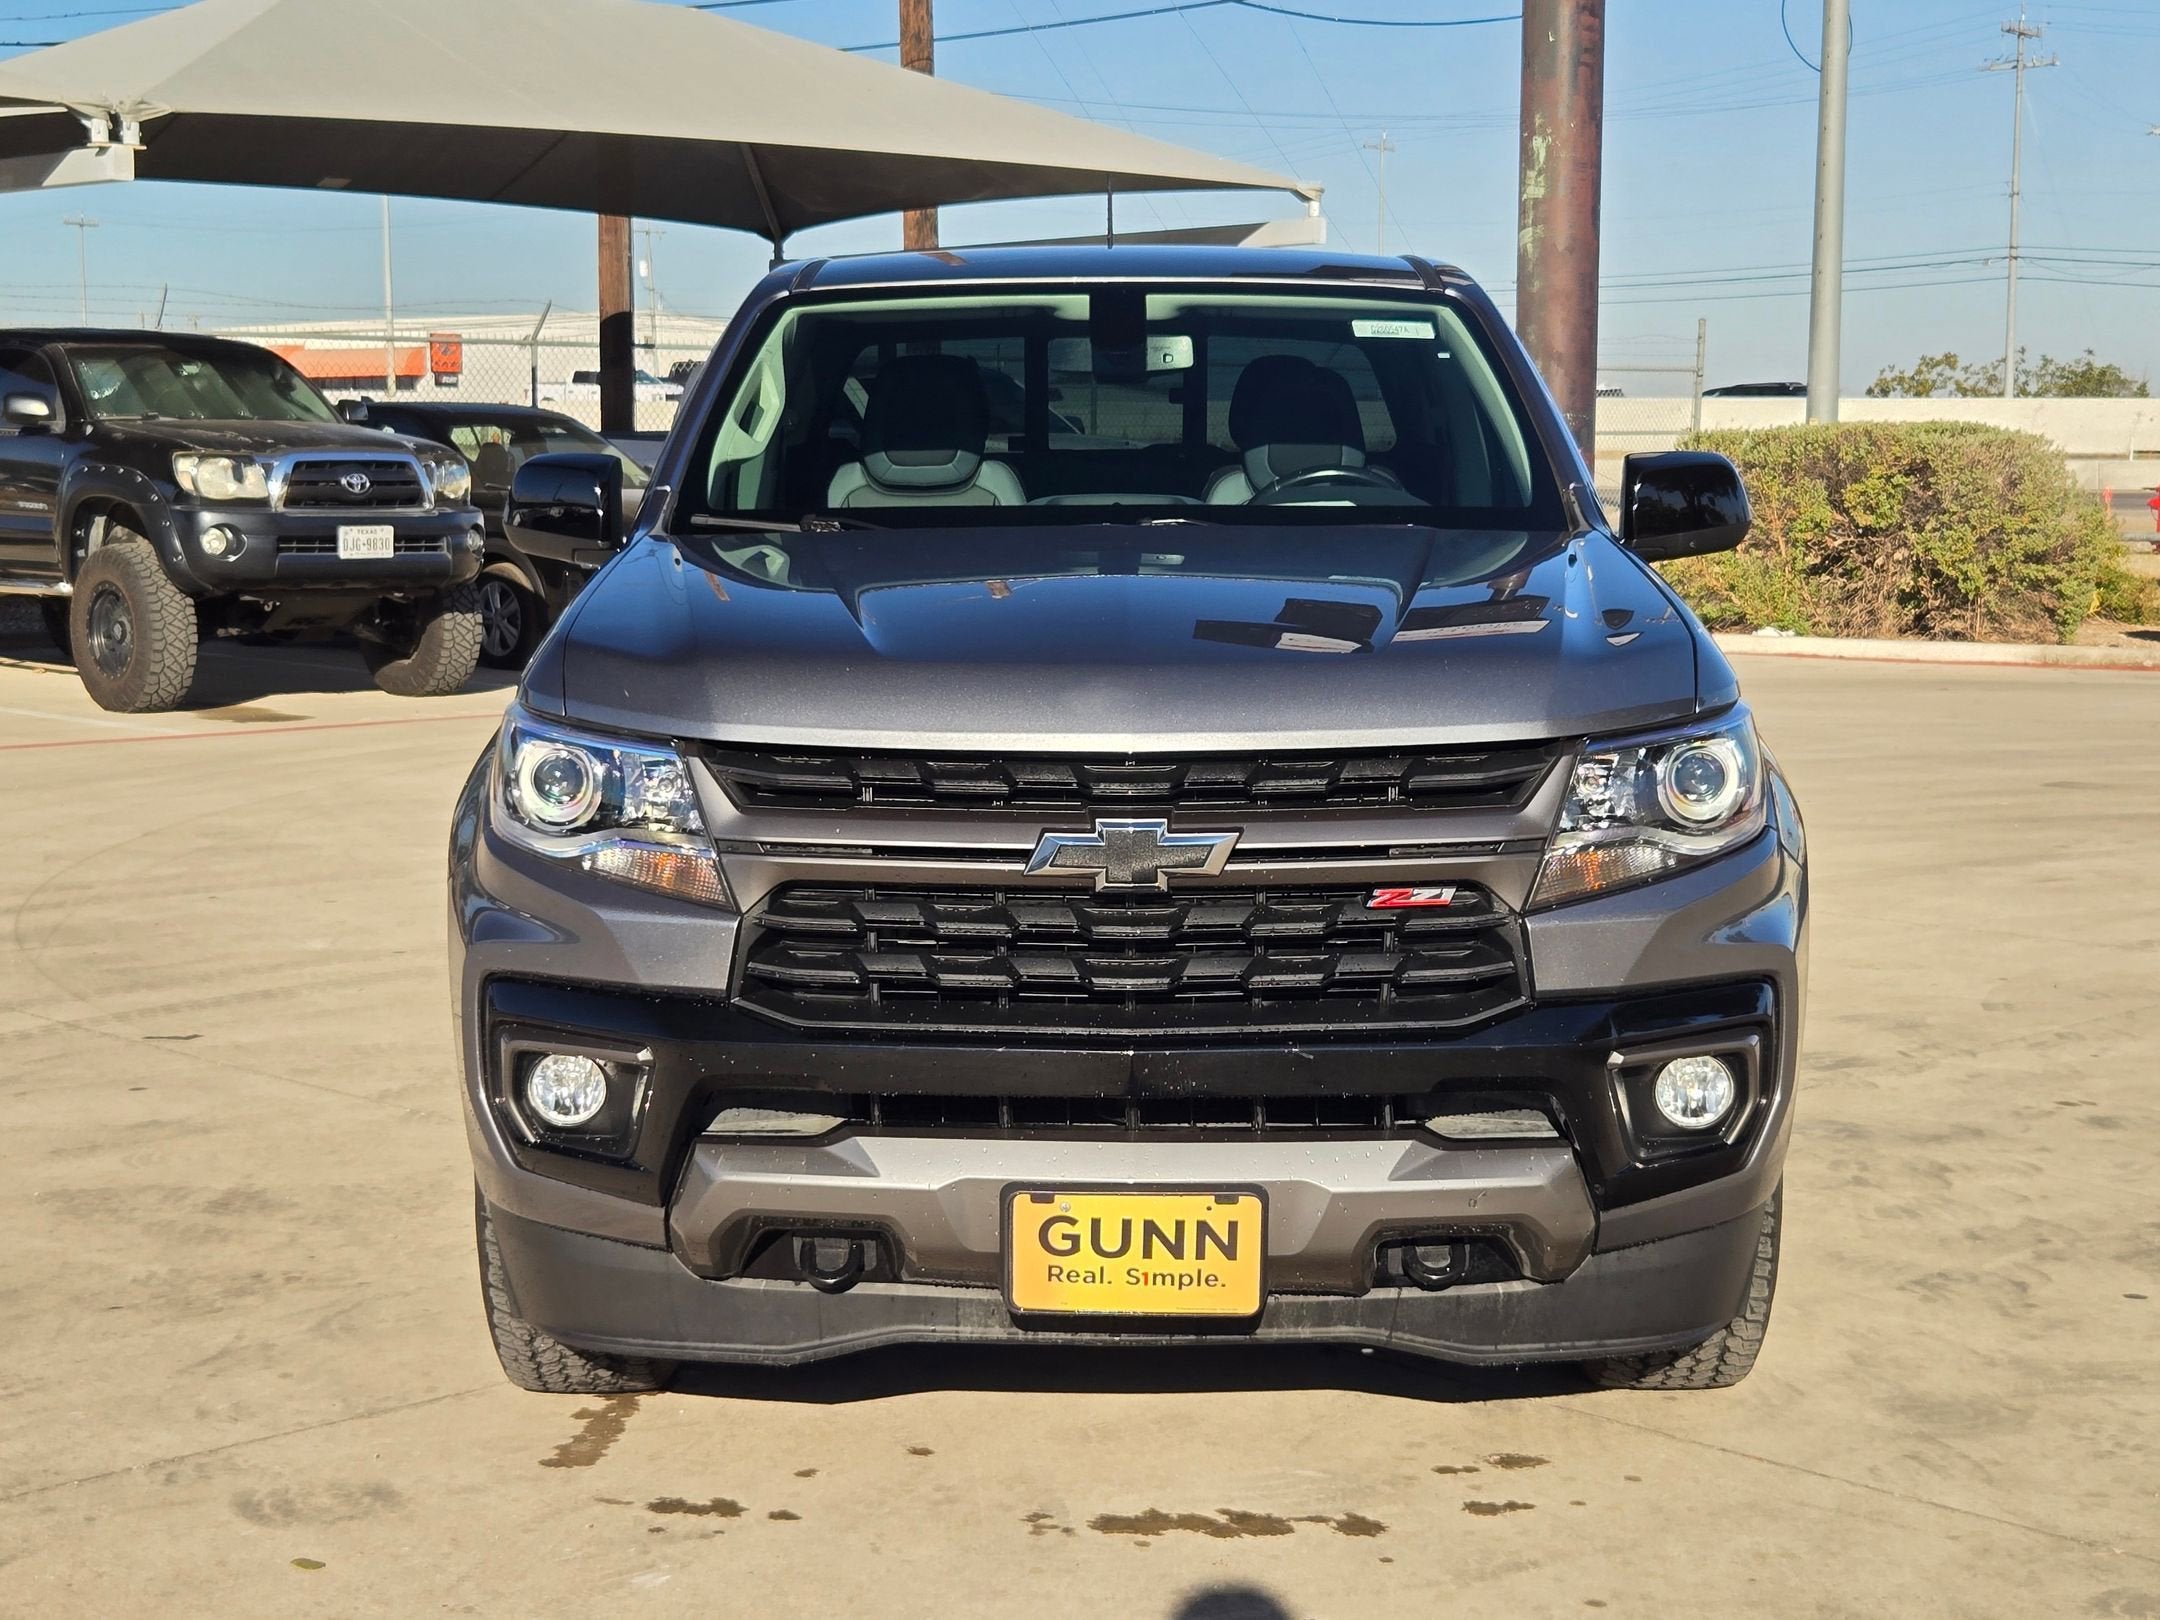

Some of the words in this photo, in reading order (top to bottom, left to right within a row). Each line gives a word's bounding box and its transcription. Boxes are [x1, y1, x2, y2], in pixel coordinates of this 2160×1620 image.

[1366, 887, 1457, 908] Z71
[1038, 1215, 1239, 1261] GUNN
[1048, 1264, 1113, 1285] Real.
